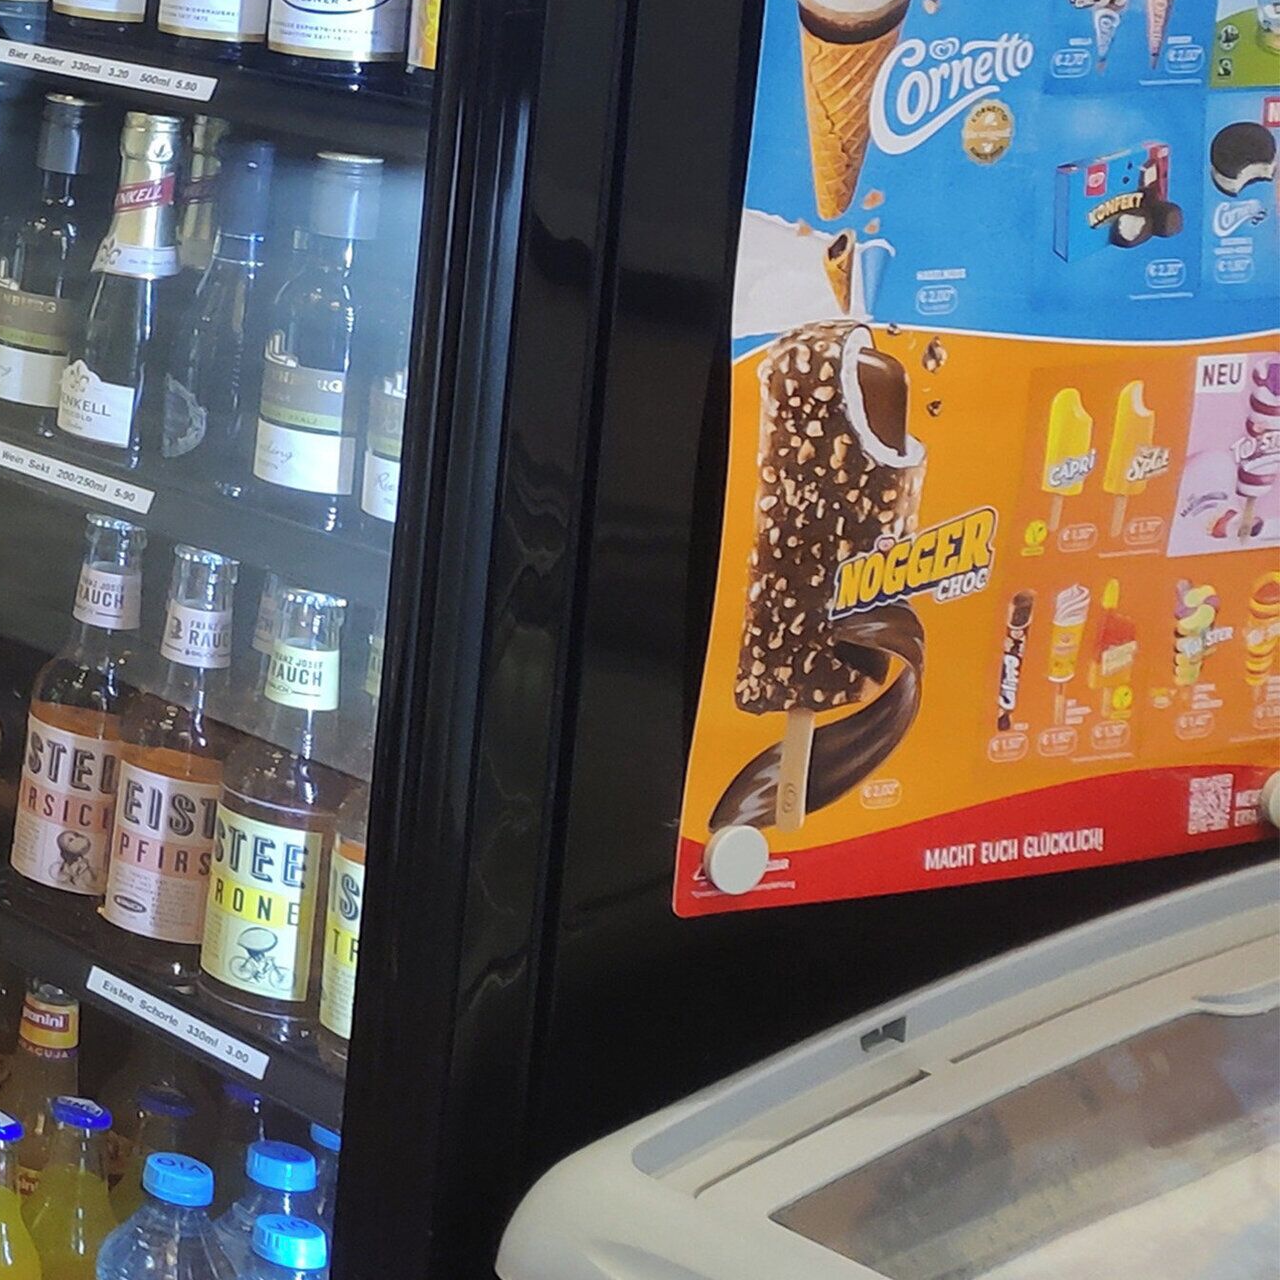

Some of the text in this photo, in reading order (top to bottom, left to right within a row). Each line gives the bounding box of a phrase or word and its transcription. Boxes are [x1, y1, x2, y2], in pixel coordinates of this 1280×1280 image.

[8, 48, 28, 61] Bier
[32, 52, 65, 67] Radler
[71, 60, 101, 75] 330ml
[108, 67, 130, 79] 3.20
[139, 73, 171, 88] 500ml
[869, 32, 1034, 155] Cornetto
[1088, 192, 1144, 228] KONFEKT
[1202, 363, 1242, 387] NEU
[2, 450, 25, 466] Wein
[28, 459, 51, 474] Sekt
[56, 468, 108, 494] 200/250ml
[835, 509, 994, 611] NOGGER
[936, 568, 989, 601] CHOC
[118, 830, 213, 876] PFIRS
[924, 827, 1104, 871] MACHT EUCH GLÜCKLICH!
[102, 979, 250, 1064] Eistee Schorle 330ml 3.00
